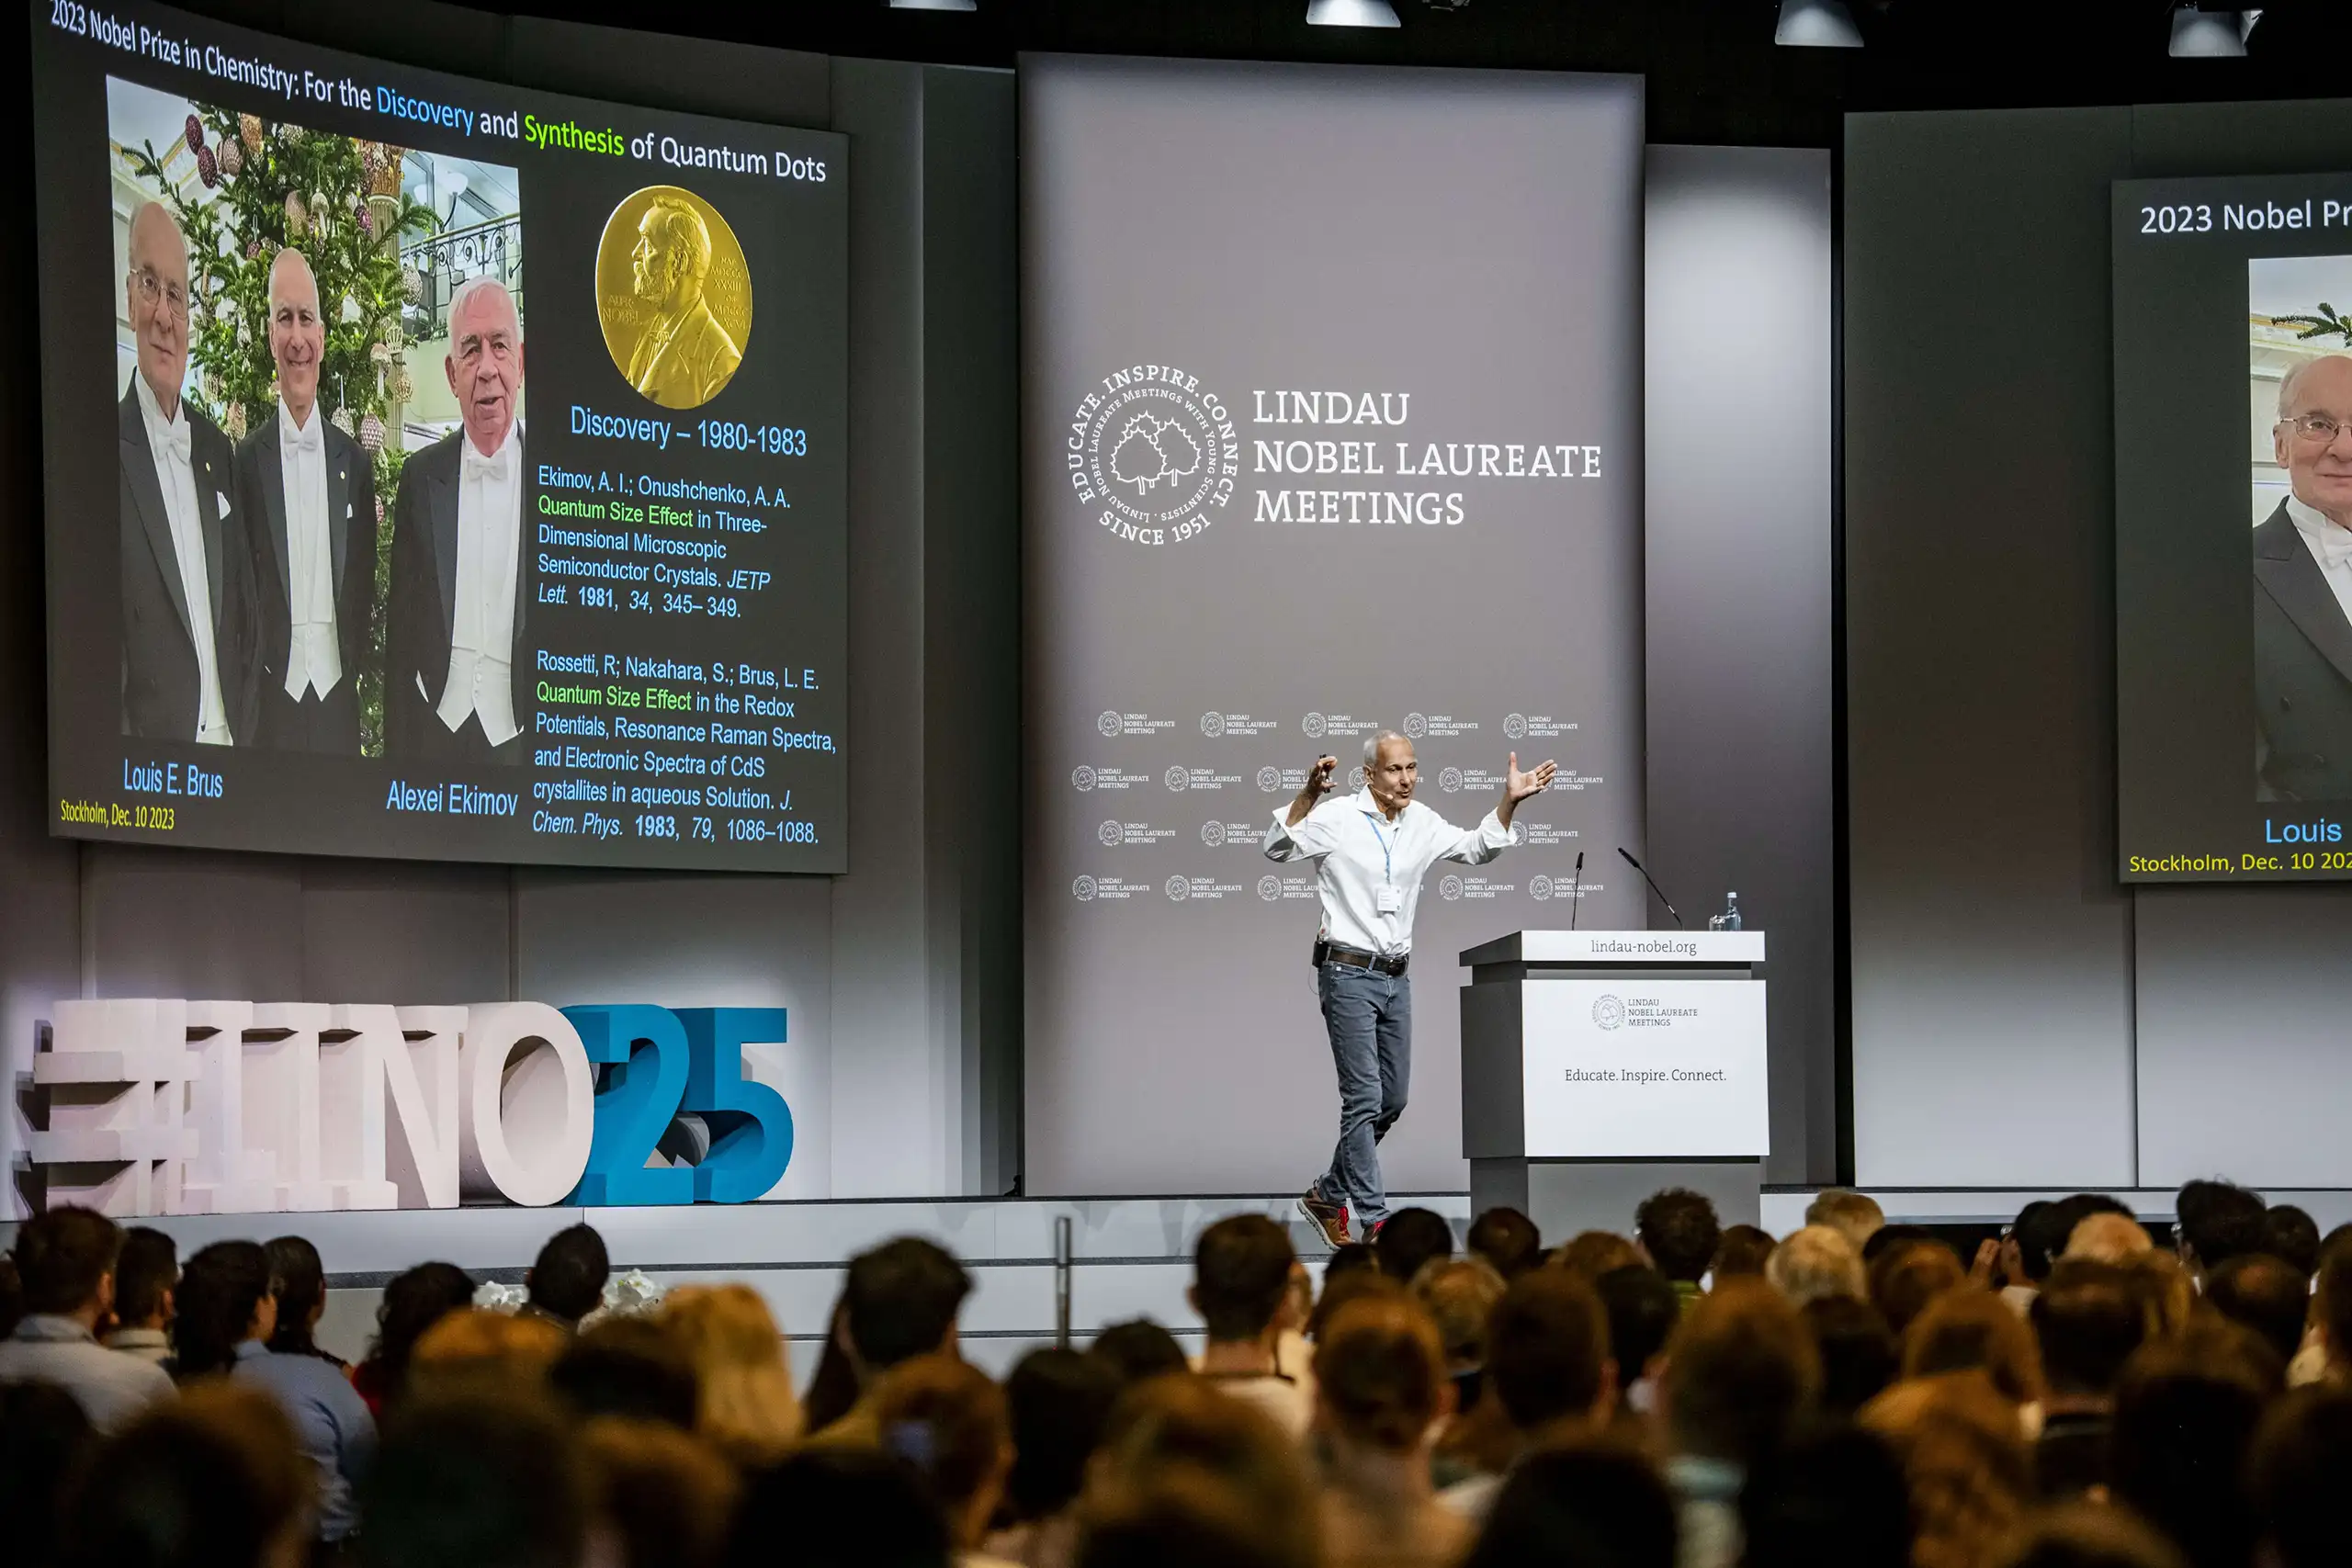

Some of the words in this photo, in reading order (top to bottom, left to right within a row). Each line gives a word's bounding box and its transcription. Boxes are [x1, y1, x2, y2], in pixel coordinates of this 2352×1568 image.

[51, 0, 85, 35] 2023
[90, 10, 136, 51] Nobel
[141, 27, 180, 65] Prize
[185, 39, 200, 70] in
[206, 46, 299, 99] Chemistry:
[305, 71, 334, 102] For
[339, 78, 371, 110] the
[377, 86, 473, 136] Discovery
[481, 111, 518, 139] and
[525, 115, 624, 155] Synthesis
[631, 132, 654, 159] of
[662, 137, 767, 175] Quantum
[775, 152, 826, 182] Dots
[2142, 206, 2212, 232] 2023
[2224, 199, 2311, 230] Nobel
[2324, 201, 2352, 226] Pr
[1087, 398, 1122, 452] LAUREATE
[1185, 400, 1209, 430] WITH
[1253, 390, 1409, 425] LINDAU
[571, 406, 671, 449] Discovery
[698, 420, 807, 456] 1980-1983
[1069, 393, 1107, 504] EDUCATE.
[1102, 366, 1199, 400] INSPIRE.
[1203, 393, 1238, 507] CONNECT.
[1205, 431, 1216, 474] YOUNG
[1254, 441, 1384, 474] NOBEL
[1396, 443, 1600, 477] LAUREATE
[539, 465, 594, 492] Ekimov,
[598, 471, 614, 491] A.
[619, 473, 632, 496] I.;
[639, 476, 750, 507] Onushchenko,
[754, 486, 770, 506] A.
[775, 489, 790, 508] A.
[1091, 457, 1110, 496] NOBEL
[538, 495, 605, 519] Quantum
[610, 502, 643, 522] Size
[650, 505, 693, 527] Effect
[698, 510, 710, 529] in
[716, 511, 767, 533] Three-
[1109, 496, 1149, 523] LINDAU
[1161, 477, 1214, 523] SCIENTISTS
[1254, 491, 1464, 525] MEETINGS
[539, 524, 628, 550] Dimensional
[634, 533, 727, 562] Microscopic
[1099, 509, 1165, 545] SINCE
[1170, 512, 1211, 542] 1951
[538, 553, 650, 581] Semiconductor
[654, 563, 721, 588] Crystals.
[727, 570, 771, 590] JETP
[538, 582, 568, 604] Lett.
[579, 586, 617, 611] 1981,
[629, 591, 652, 614] 34,
[537, 650, 598, 677] Rossetti,
[605, 655, 619, 678] R;
[627, 656, 707, 684] Nakahara,
[713, 662, 733, 686] S.;
[740, 664, 778, 689] Brus,
[785, 668, 797, 687] L.
[804, 670, 819, 689] E.
[537, 682, 602, 705] Quantum
[606, 685, 640, 707] Size
[646, 688, 691, 710] Effect
[696, 692, 709, 712] in
[715, 693, 740, 714] the
[745, 694, 794, 717] Redox
[537, 712, 608, 739] Potentials,
[616, 717, 706, 742] Resonance
[711, 723, 767, 746] Raman
[773, 728, 835, 754] Spectra,
[124, 759, 162, 793] Louis
[167, 762, 182, 794] E.
[187, 765, 222, 797] Brus
[535, 746, 560, 766] and
[566, 746, 639, 770] Electronic
[644, 751, 706, 776] Spectra
[711, 755, 727, 775] of
[731, 756, 764, 777] CdS
[387, 781, 443, 812] Alexei
[449, 784, 518, 816] Ekimov
[534, 779, 606, 804] crystallites
[612, 781, 626, 802] in
[631, 787, 700, 808] aqueous
[707, 786, 774, 809] Solution.
[780, 790, 792, 810] J.
[62, 799, 108, 828] Stockholm,
[112, 804, 131, 826] Dec.
[135, 806, 147, 827] 10
[150, 807, 174, 829] 2023
[533, 810, 576, 833] Chem.
[582, 813, 622, 840] Phys.
[636, 815, 679, 840] 1983,
[693, 817, 715, 842] 79,
[2267, 818, 2342, 842] Louis
[2130, 854, 2234, 874] Stockholm,
[2243, 854, 2282, 870] Dec.
[2291, 853, 2313, 869] 10
[1592, 941, 1696, 955] lindau-nobel.org
[1566, 1069, 1618, 1081] Educate.
[1622, 1069, 1668, 1085] Inspire.
[1672, 1069, 1726, 1081] Connect.
